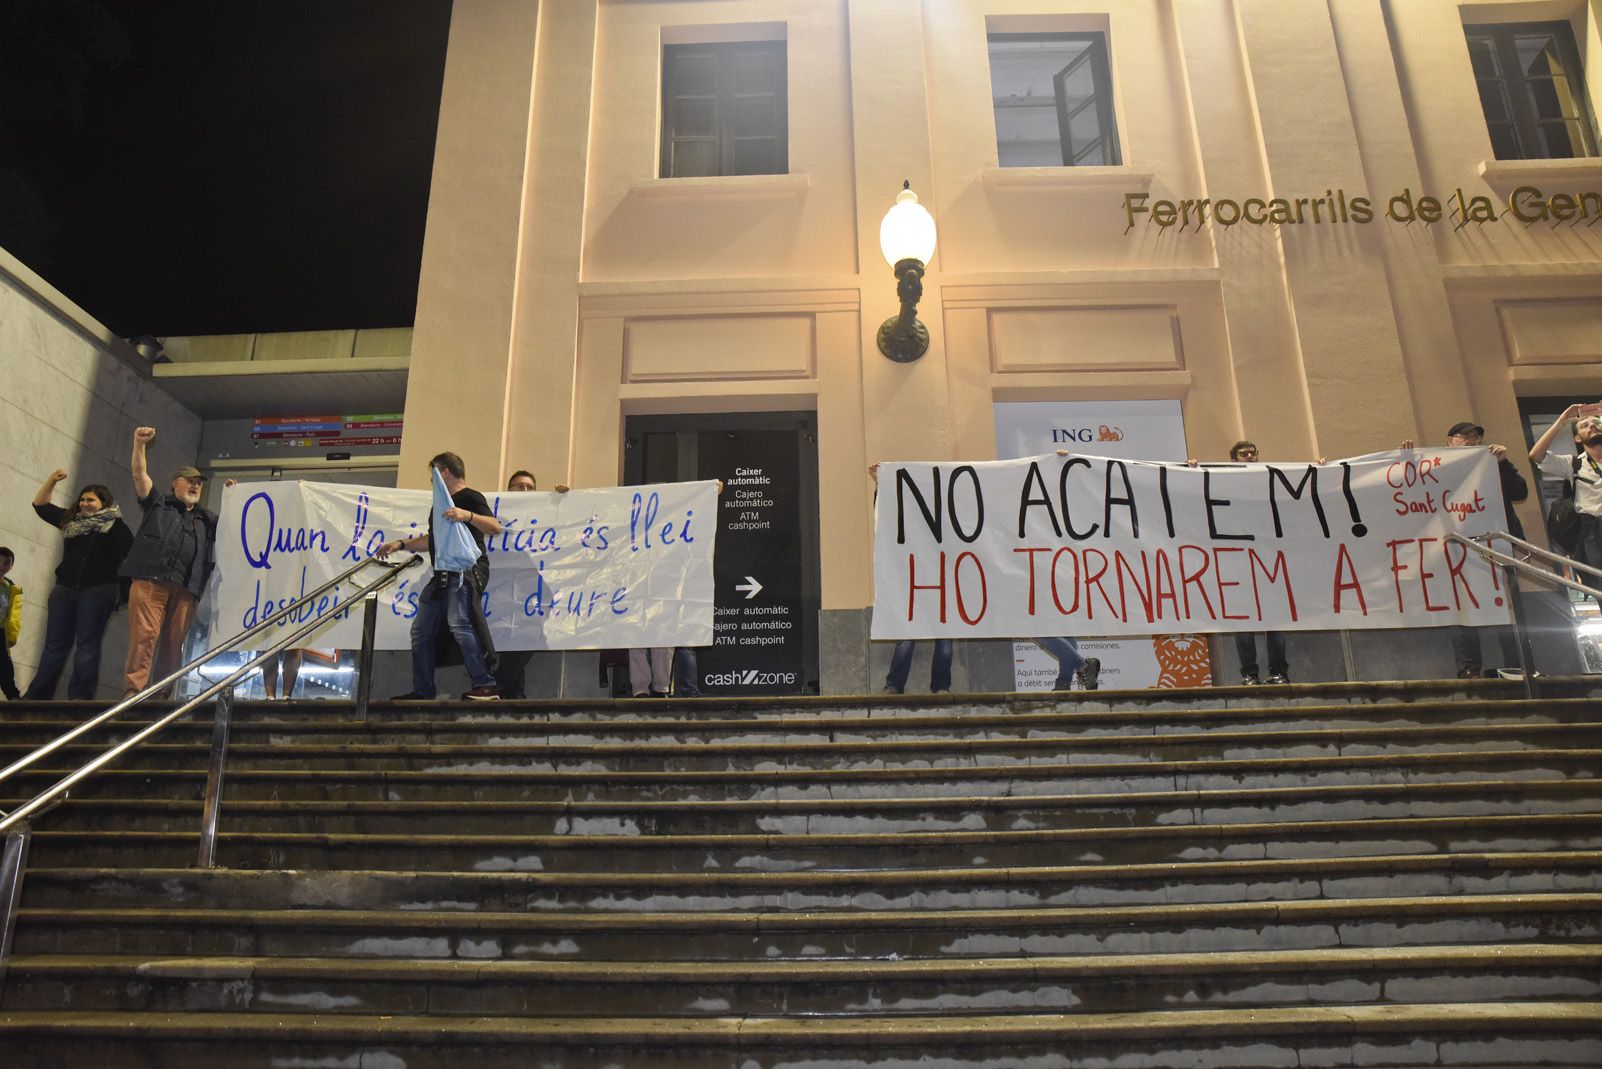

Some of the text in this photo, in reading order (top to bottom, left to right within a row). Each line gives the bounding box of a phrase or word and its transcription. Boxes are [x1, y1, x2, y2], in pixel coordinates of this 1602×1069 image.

[1125, 189, 1374, 227] Ferrocarrils
[1388, 188, 1442, 223] de
[1455, 188, 1498, 223] la
[1051, 428, 1093, 443] ING
[735, 467, 763, 476] Caixer
[727, 475, 771, 485] automàtic
[735, 489, 763, 500] Cajero
[725, 498, 774, 508] automático
[896, 465, 985, 544] NO
[1393, 489, 1486, 522] Sant Cugat
[740, 512, 759, 520] ATM
[240, 491, 330, 569] Quan
[580, 513, 610, 551] és
[630, 491, 694, 552] llei
[728, 520, 770, 530] cashpoint
[908, 532, 1504, 626] HO TORNAREM A FER!
[391, 579, 419, 619] és
[743, 605, 789, 615] automàtic
[713, 620, 792, 633] ajero automático
[715, 635, 785, 646] ATM cashpoint
[1015, 642, 1120, 652] dinero comisiones.
